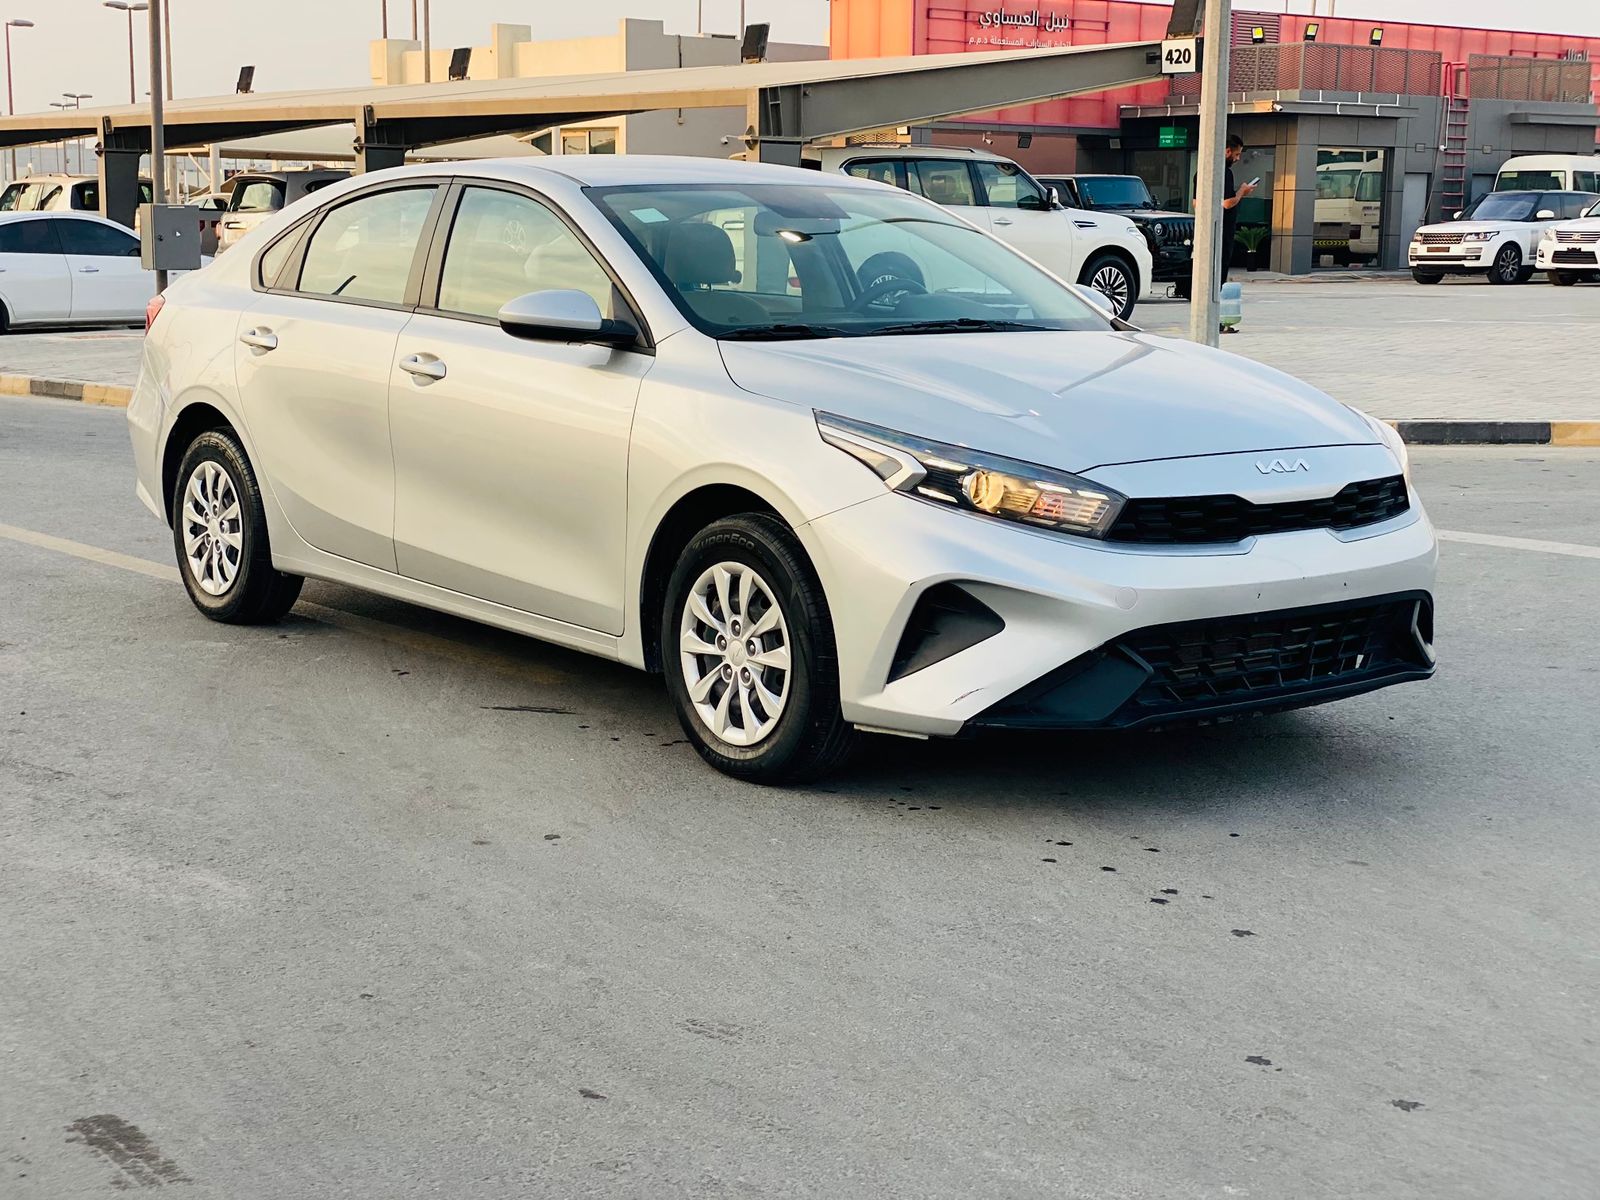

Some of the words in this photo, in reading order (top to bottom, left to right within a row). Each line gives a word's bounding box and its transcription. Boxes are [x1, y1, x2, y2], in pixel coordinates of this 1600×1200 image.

[979, 8, 1039, 29] العيساوي
[1045, 11, 1069, 32] نبيل
[990, 36, 1024, 46] المستعملة
[1165, 48, 1191, 64] 420
[1255, 458, 1310, 475] KIA
